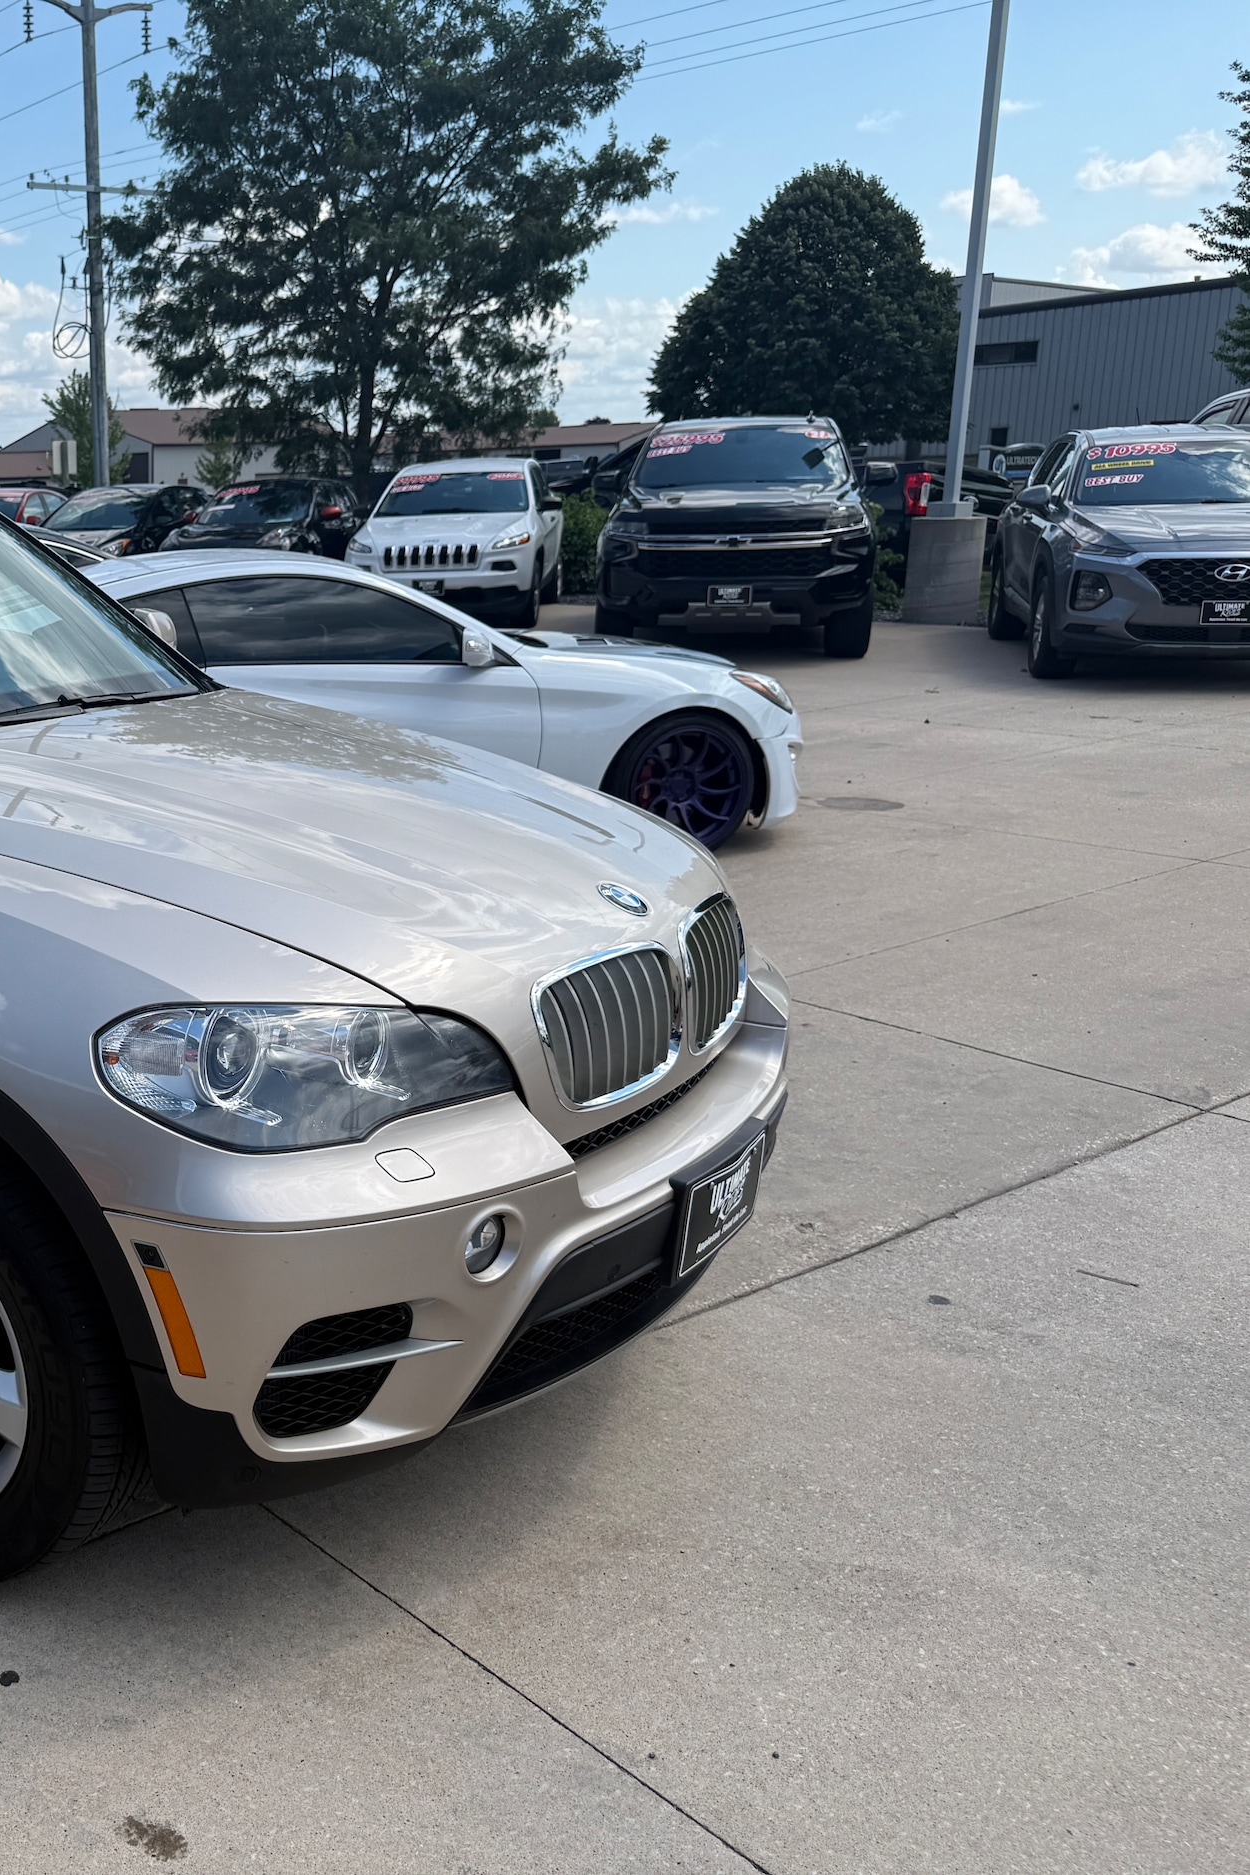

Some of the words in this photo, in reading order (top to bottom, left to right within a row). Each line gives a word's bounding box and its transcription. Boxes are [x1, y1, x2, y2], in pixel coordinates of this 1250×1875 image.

[1085, 475, 1116, 487] BEST
[1118, 473, 1144, 484] BUY
[710, 1156, 751, 1215] ULTIMATE
